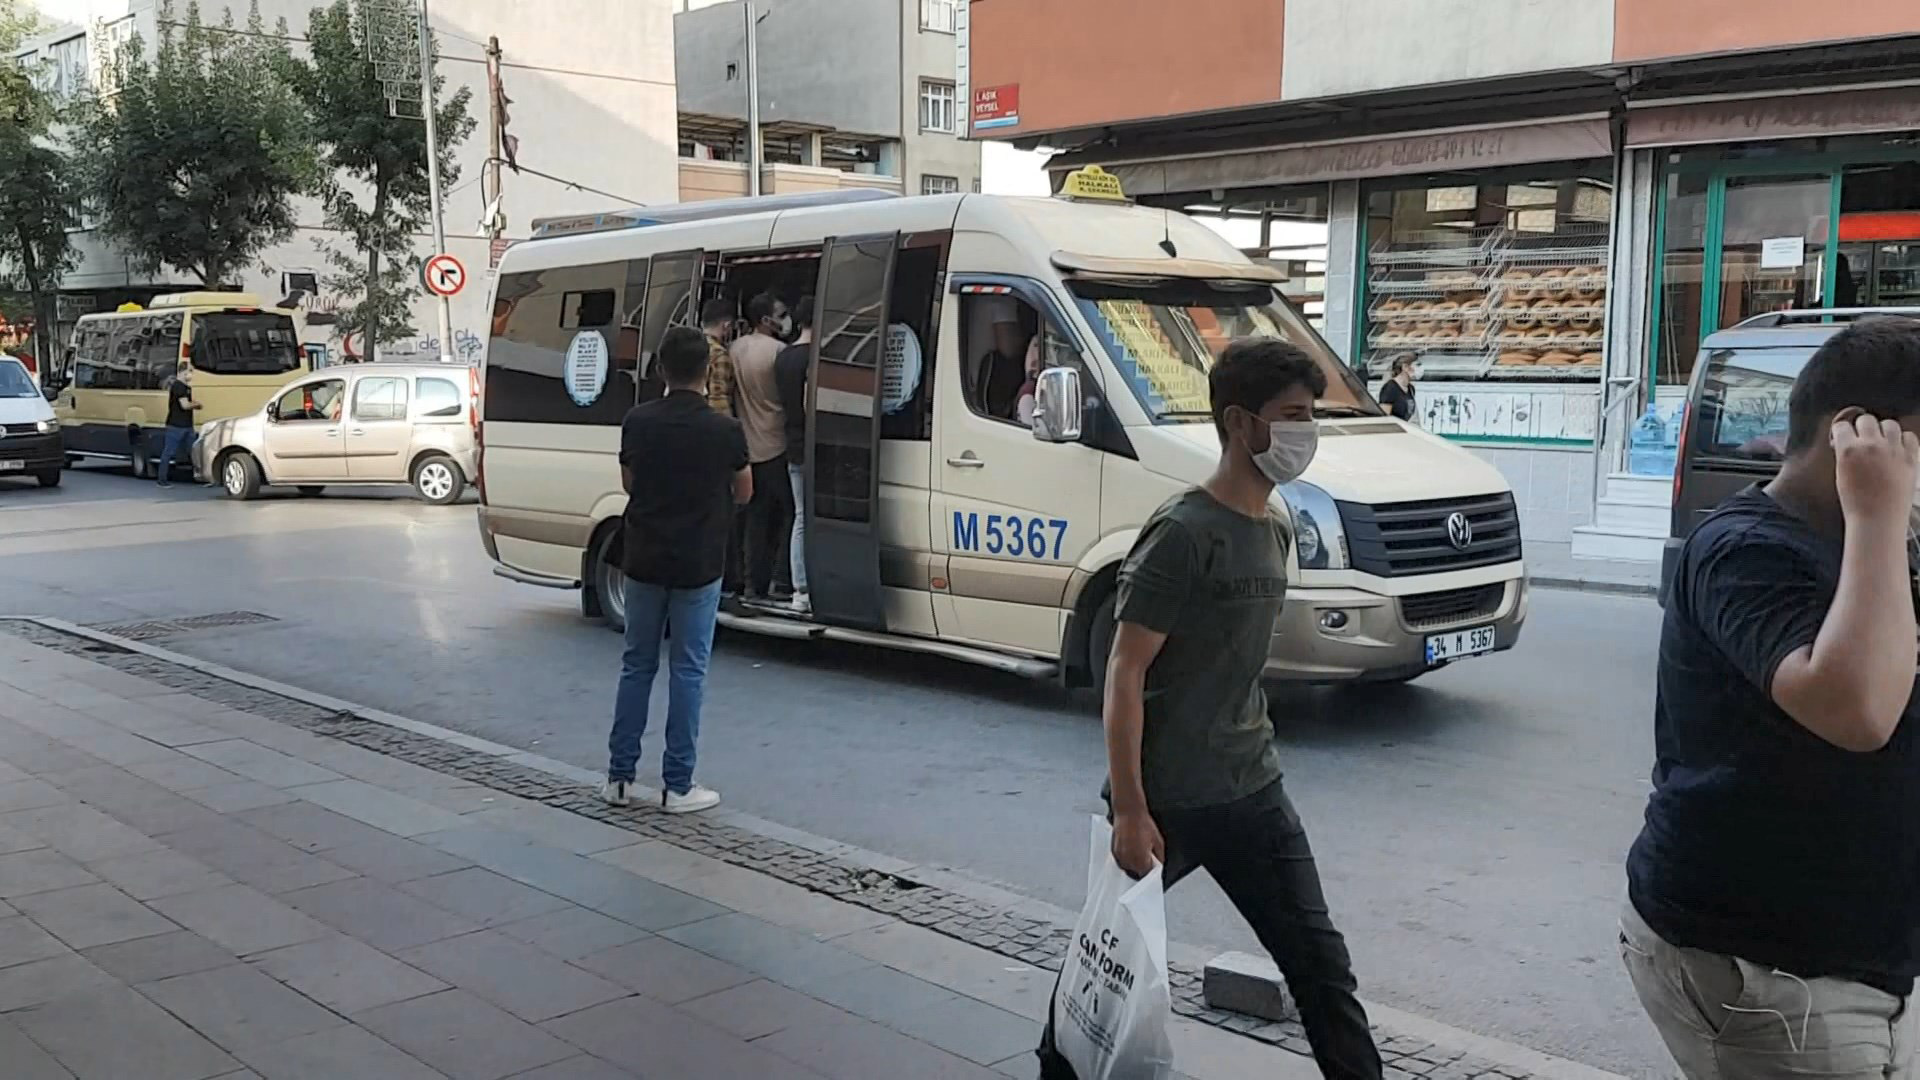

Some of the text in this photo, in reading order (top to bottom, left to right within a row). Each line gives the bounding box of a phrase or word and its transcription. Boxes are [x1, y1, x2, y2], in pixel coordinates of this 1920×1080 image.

[1434, 628, 1493, 656] 34 M 5367
[1101, 928, 1119, 951] CF
